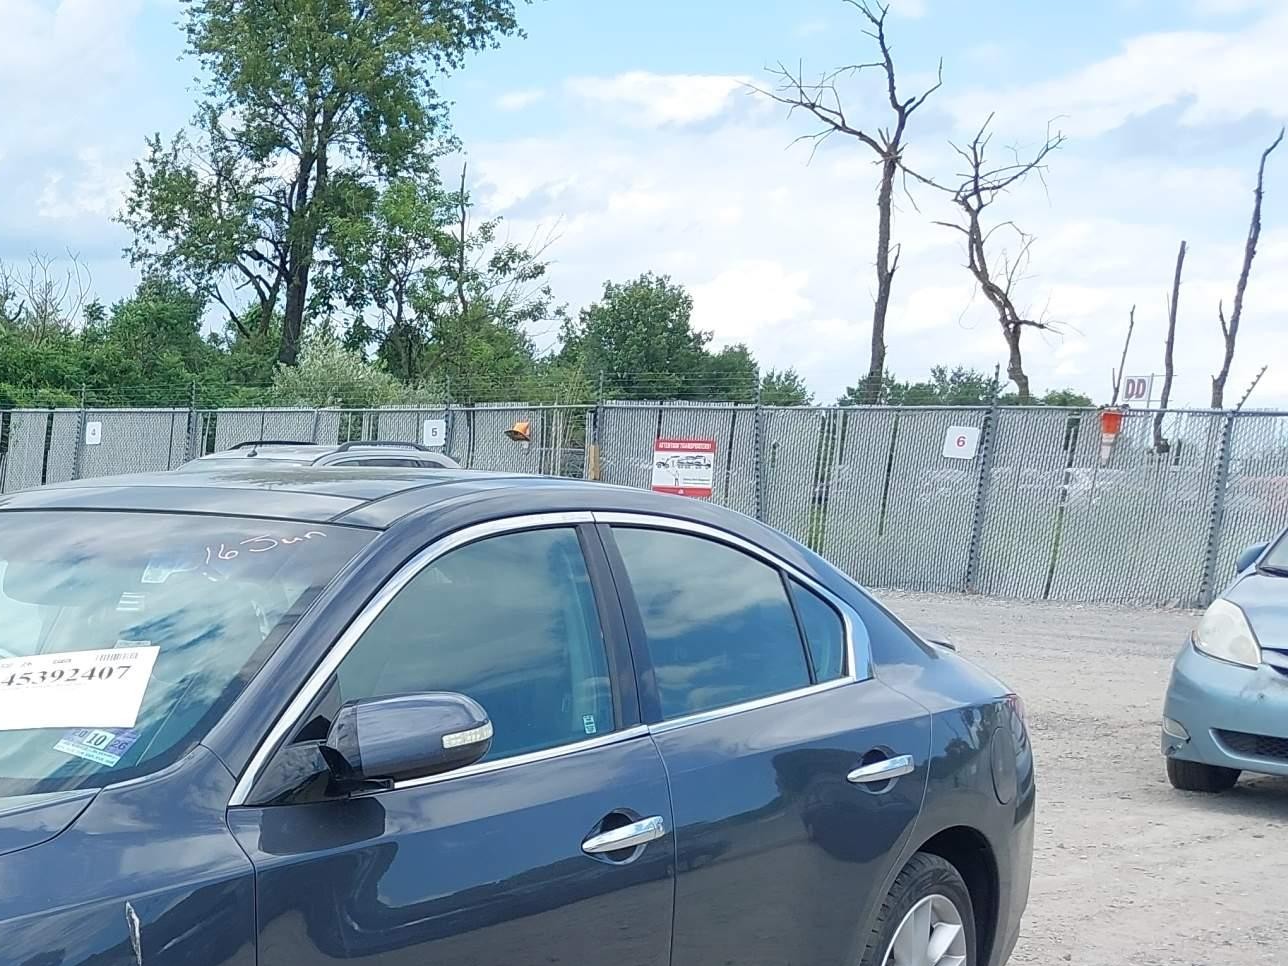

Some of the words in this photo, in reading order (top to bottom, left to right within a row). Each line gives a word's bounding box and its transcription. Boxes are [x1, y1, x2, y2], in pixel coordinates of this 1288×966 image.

[431, 427, 438, 437] 5
[956, 435, 966, 447] 6
[205, 543, 239, 565] 16
[0, 665, 132, 687] 45392407
[86, 732, 108, 747] 10
[113, 739, 129, 751] 26
